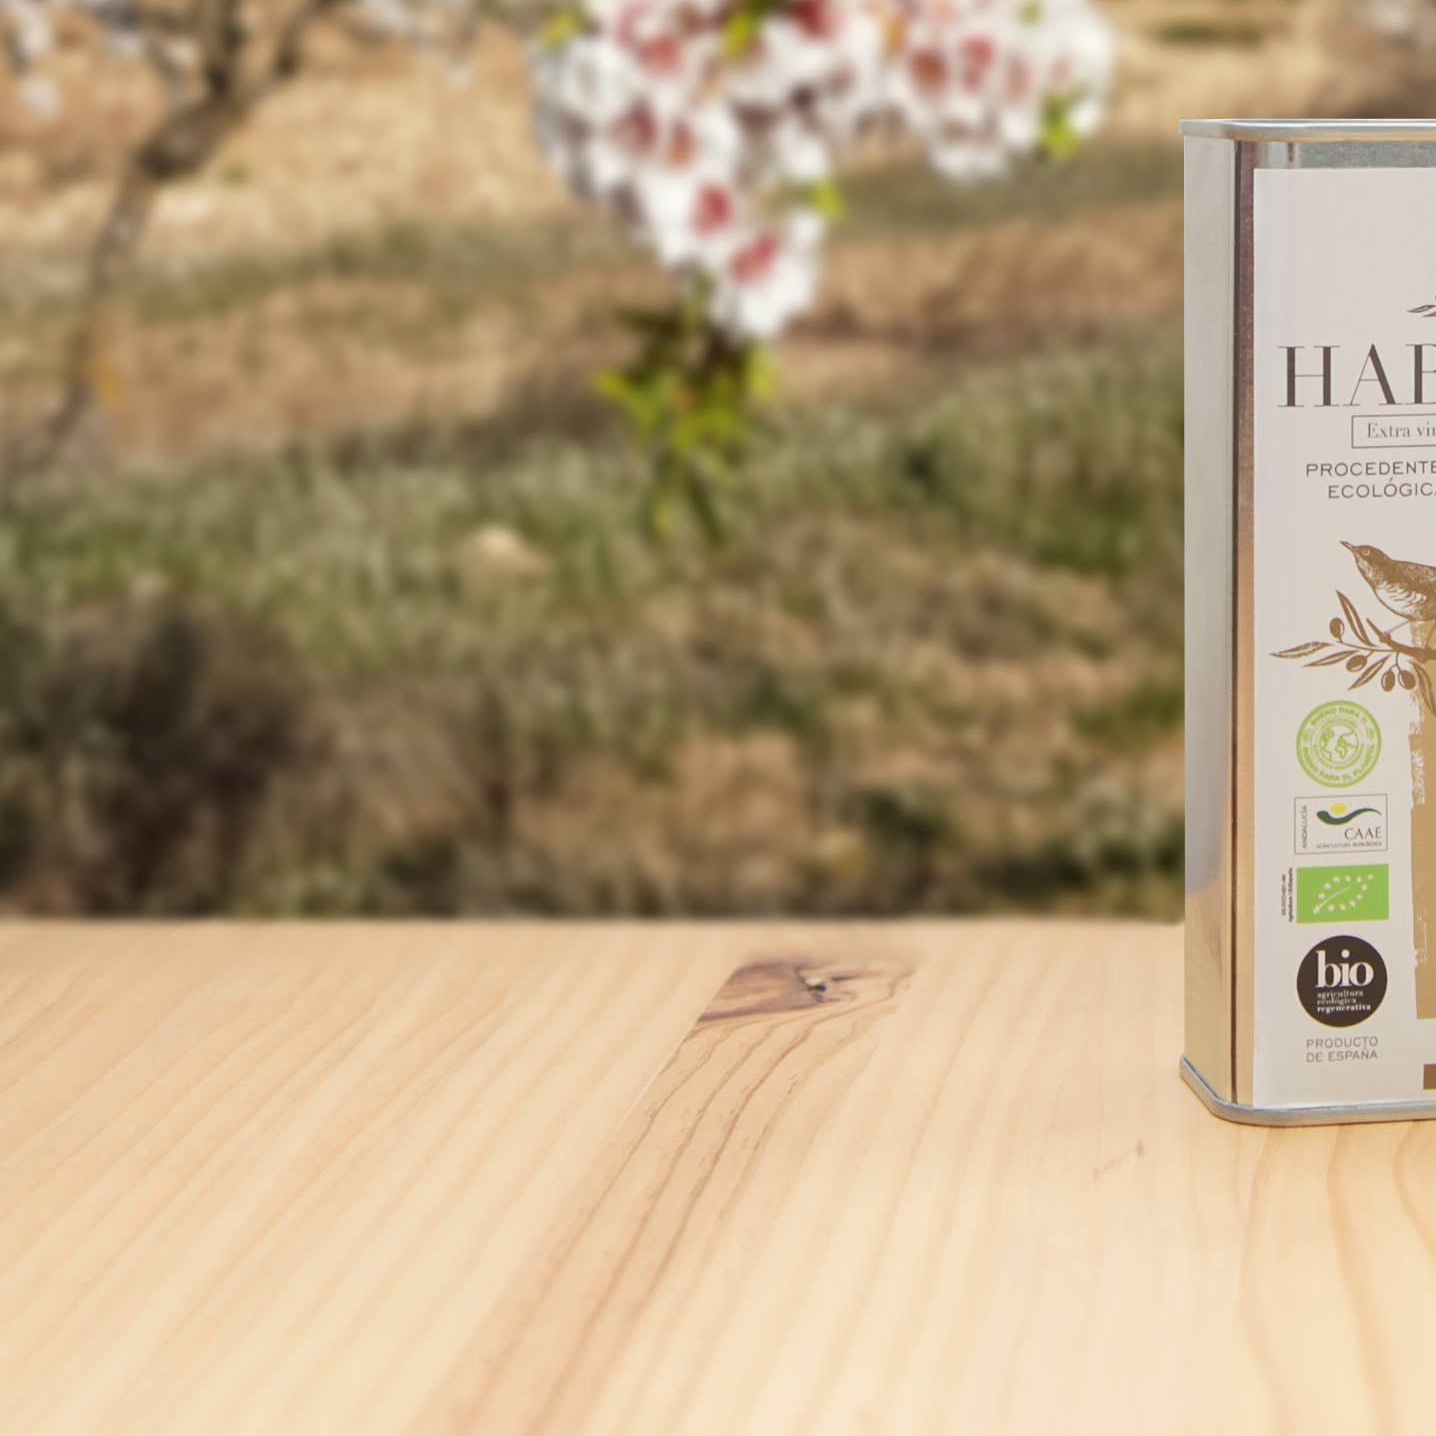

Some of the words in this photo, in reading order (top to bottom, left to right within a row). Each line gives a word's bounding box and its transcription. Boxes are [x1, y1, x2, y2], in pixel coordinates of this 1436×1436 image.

[1366, 421, 1411, 439] Extra
[1344, 826, 1382, 841] CAAE
[1315, 949, 1374, 988] bio
[1317, 989, 1364, 1000] agricultura
[1317, 1003, 1371, 1014] regenerativa
[1306, 1036, 1379, 1050] PRODUCTO
[1306, 1052, 1324, 1063] DE
[1328, 1048, 1379, 1062] ESPAÑA
